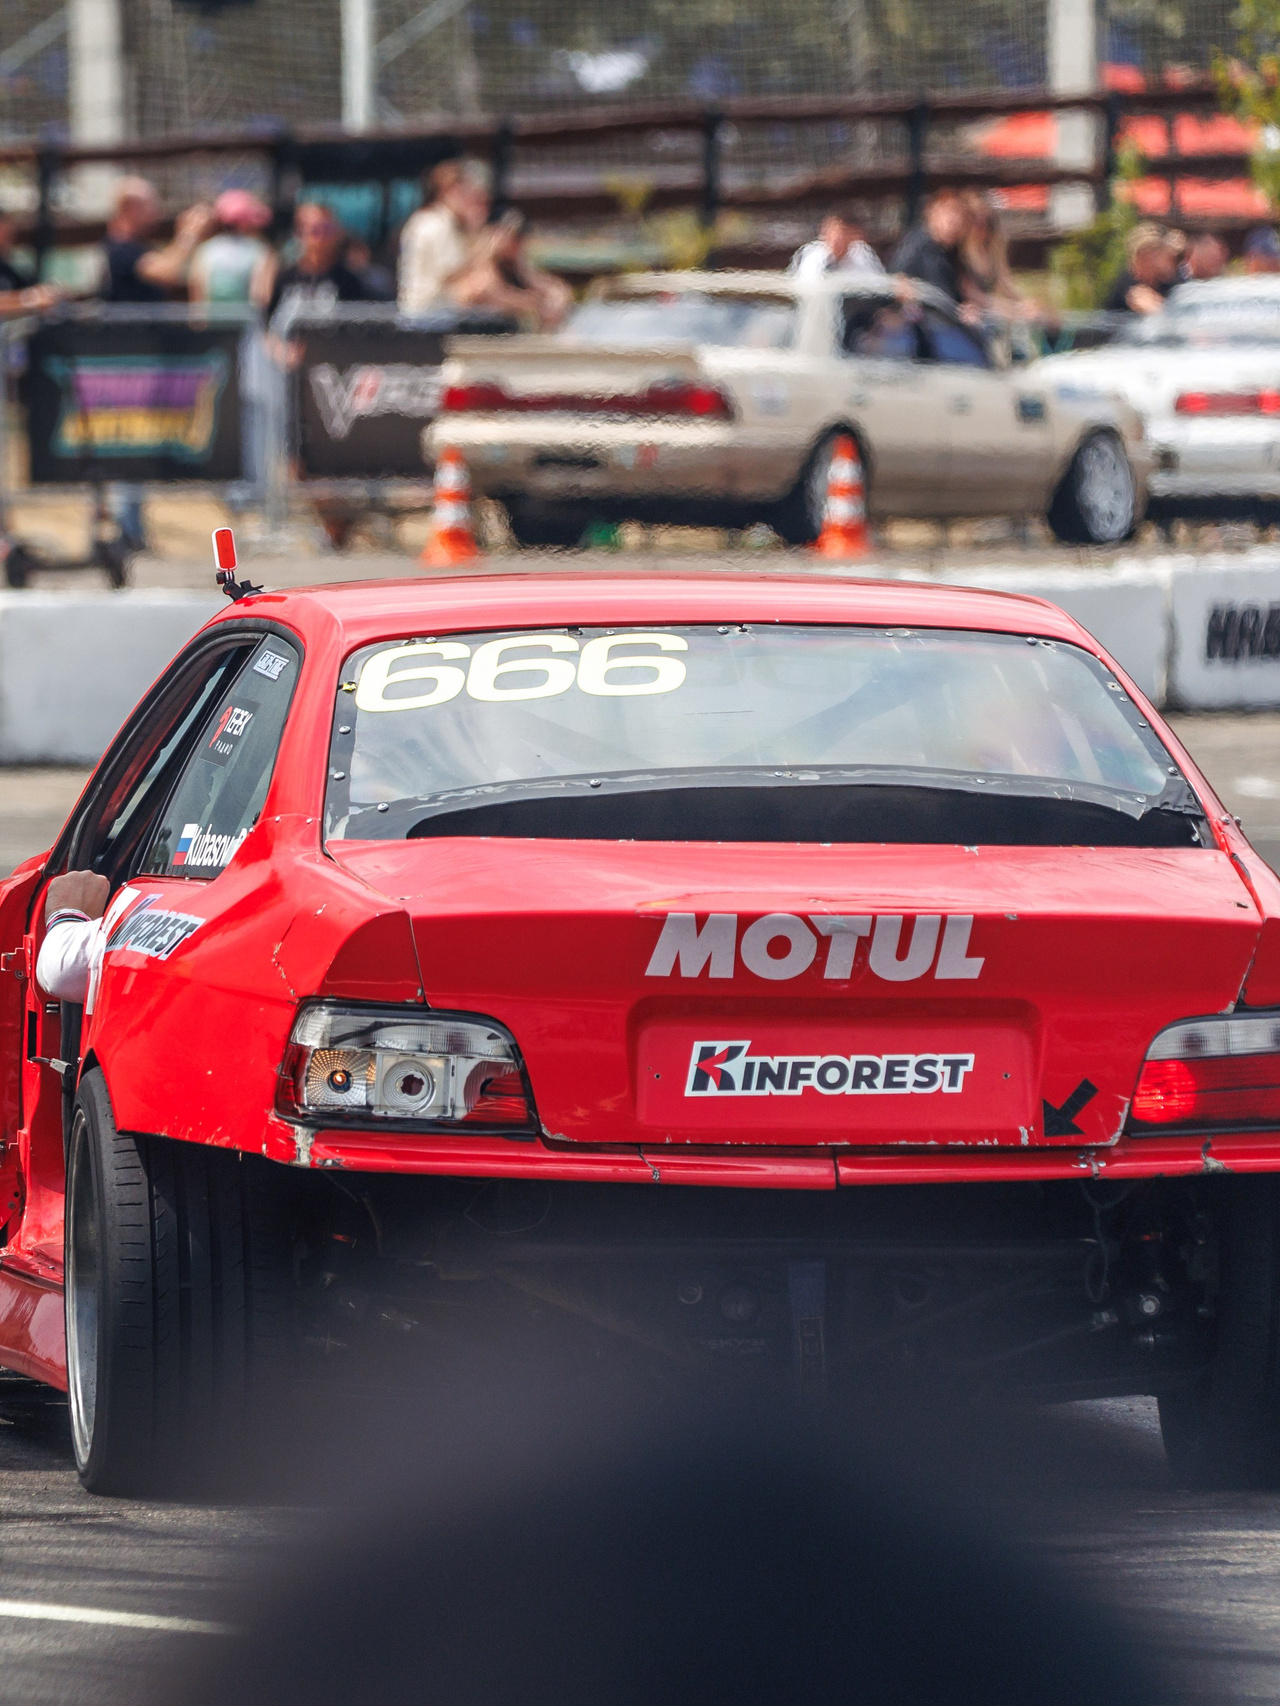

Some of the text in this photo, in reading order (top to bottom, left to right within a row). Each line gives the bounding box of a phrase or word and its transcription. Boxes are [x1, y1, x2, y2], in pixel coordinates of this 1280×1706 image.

[355, 633, 688, 713] 666
[645, 912, 986, 982] MOTUL
[690, 1044, 971, 1093] KINFOREST
